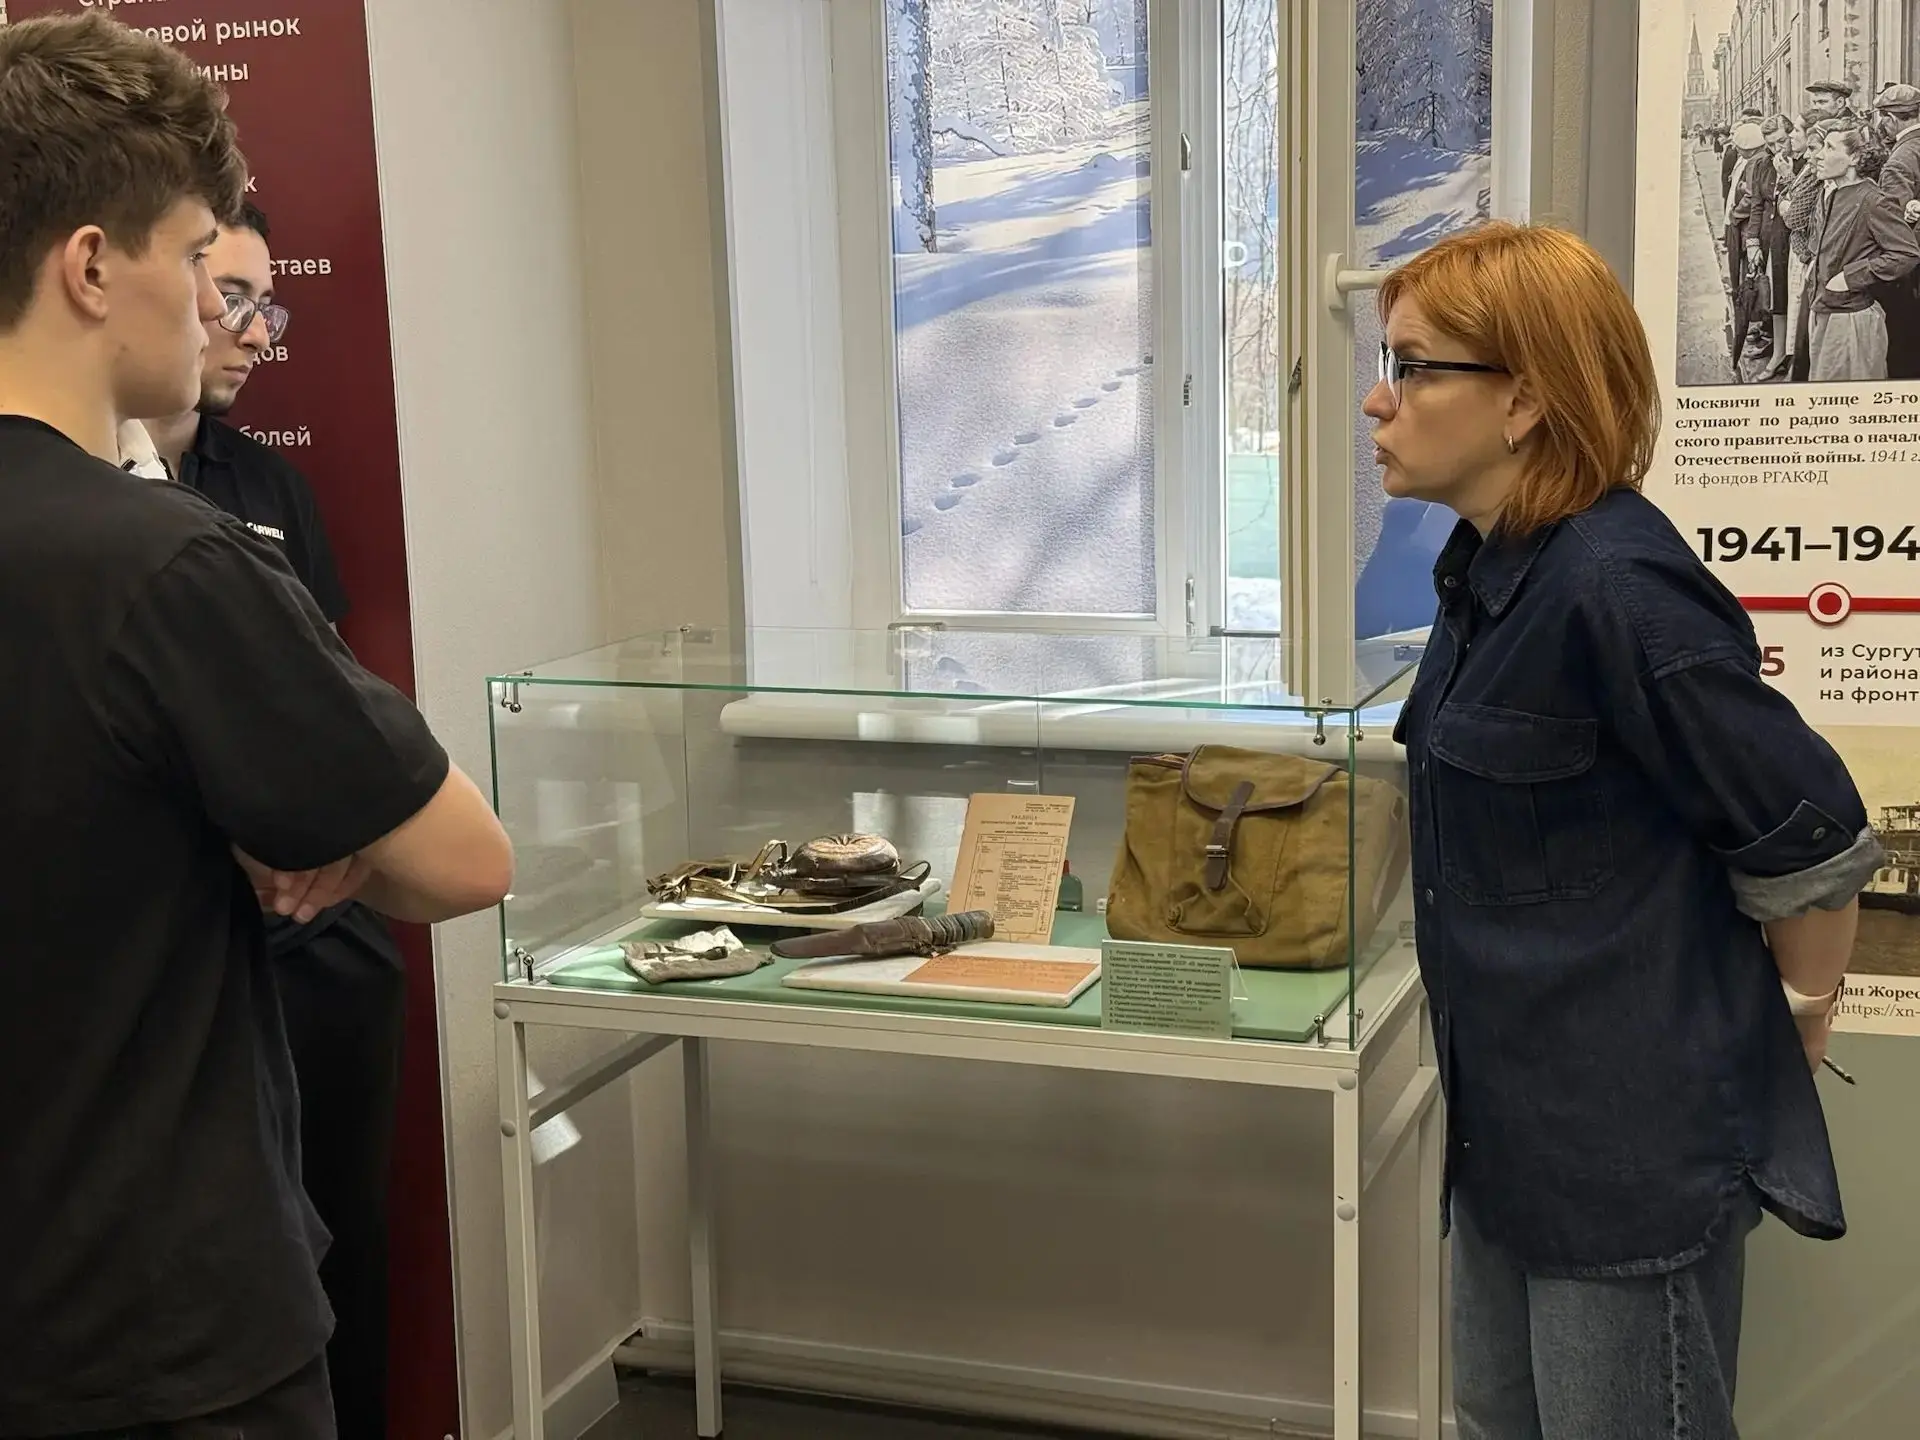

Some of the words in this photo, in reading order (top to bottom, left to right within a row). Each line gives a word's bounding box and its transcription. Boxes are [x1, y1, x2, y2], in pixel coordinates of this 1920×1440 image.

[129, 18, 207, 43] овой
[216, 18, 301, 45] рынок
[190, 63, 249, 82] ины
[1676, 397, 1760, 410] Москвичи
[1775, 397, 1795, 407] на
[1808, 395, 1859, 410] улице
[1873, 392, 1919, 404] 25-го
[1675, 418, 1750, 432] слушают
[1759, 416, 1780, 426] по
[1789, 414, 1839, 429] радио
[1848, 413, 1919, 425] заявлен
[1675, 437, 1720, 448] ского
[1724, 434, 1850, 450] правительства
[1854, 434, 1864, 443] о
[1868, 433, 1920, 443] начал
[1674, 451, 1801, 467] Отечественной
[1805, 450, 1866, 464] войны.
[1870, 449, 1906, 463] 1941
[1674, 473, 1694, 485] Из
[1698, 472, 1759, 488] фондов
[1763, 470, 1829, 485] РГАКФД
[1820, 646, 1844, 657] из
[1820, 667, 1832, 679] и
[1840, 665, 1918, 682] района
[1820, 689, 1844, 700] на
[1851, 686, 1919, 704] фронт
[1844, 986, 1865, 996] ан
